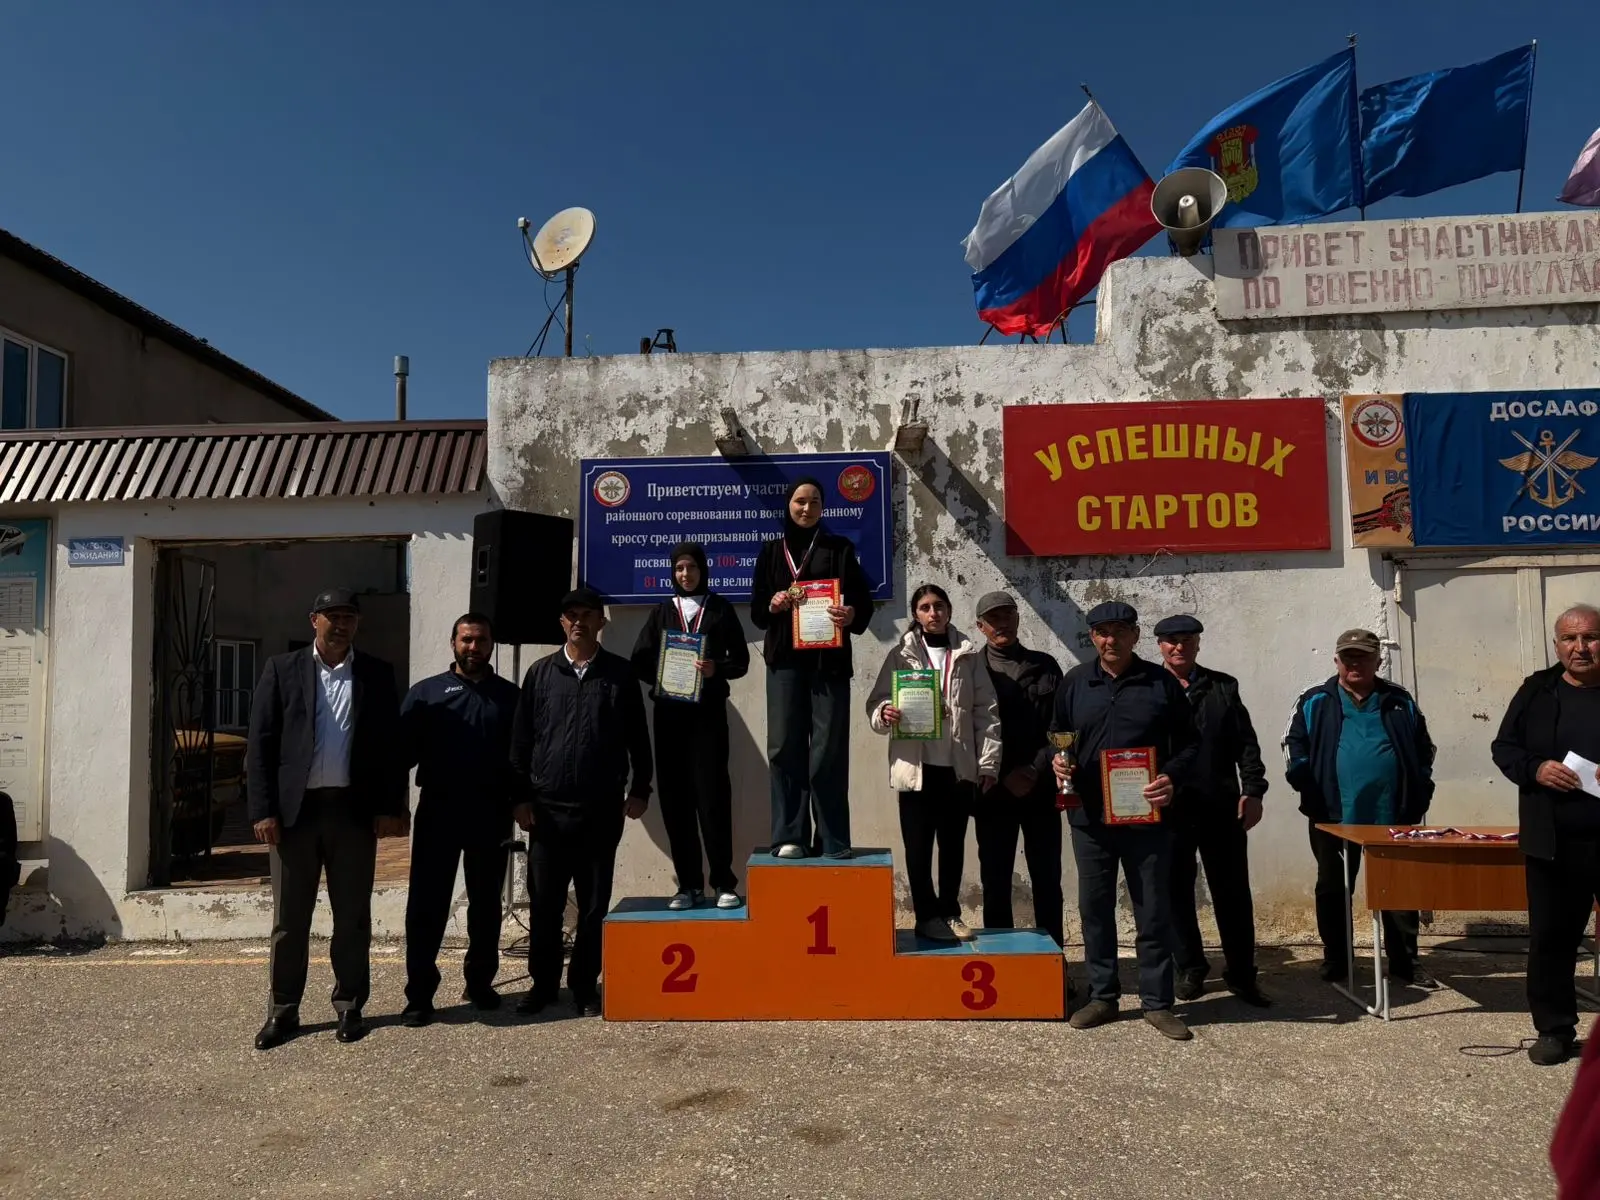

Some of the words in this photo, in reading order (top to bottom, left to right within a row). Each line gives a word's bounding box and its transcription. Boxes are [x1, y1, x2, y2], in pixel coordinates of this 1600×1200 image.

[1237, 230, 1365, 270] ПРИВЕТ
[1243, 276, 1281, 309] ПО
[1490, 400, 1598, 421] ДОСААФ
[1034, 424, 1296, 481] УСПЕШНЫХ
[647, 483, 741, 501] Приветствуем
[744, 484, 789, 499] участн
[605, 509, 664, 524] районного
[666, 509, 742, 524] соревнования
[744, 509, 758, 519] по
[1077, 492, 1259, 531] СТАРТОВ
[611, 534, 648, 547] кроссу
[650, 533, 682, 547] среди
[73, 551, 120, 560] ОЖИДАНИЯ
[716, 555, 758, 568] 100-лет
[722, 577, 754, 587] велик
[806, 905, 836, 955] 1
[661, 943, 698, 993] 2
[960, 960, 998, 1011] 3
